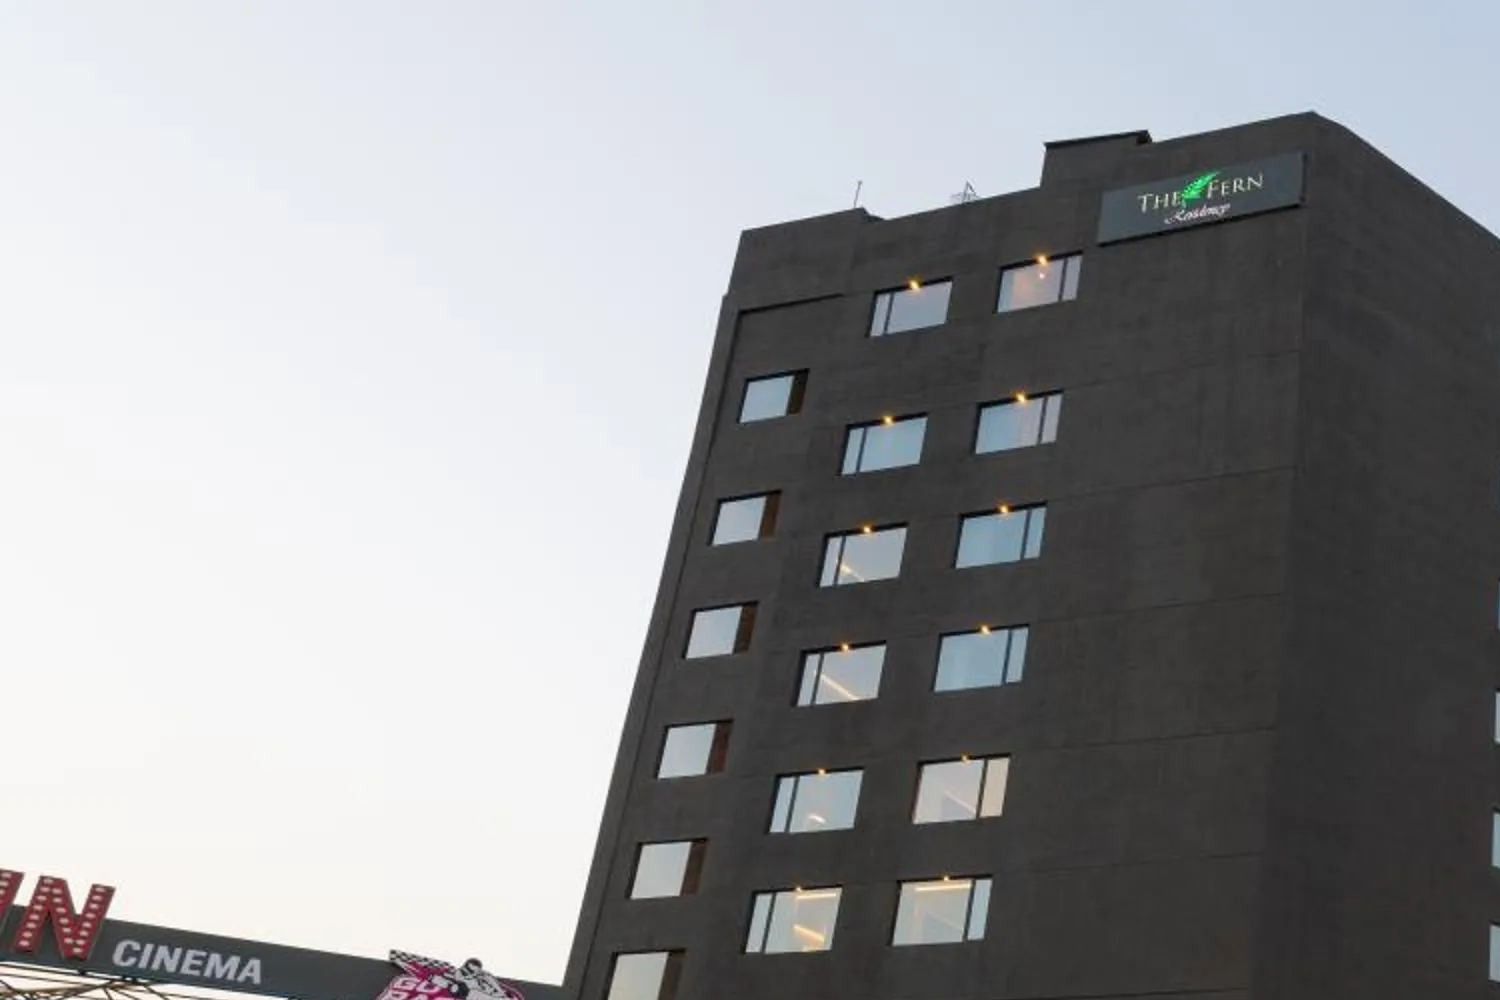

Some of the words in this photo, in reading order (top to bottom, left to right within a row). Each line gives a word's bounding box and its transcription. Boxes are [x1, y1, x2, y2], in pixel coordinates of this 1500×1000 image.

[1138, 191, 1186, 213] THE
[1206, 172, 1263, 199] FERN
[112, 940, 262, 984] CINEMA
